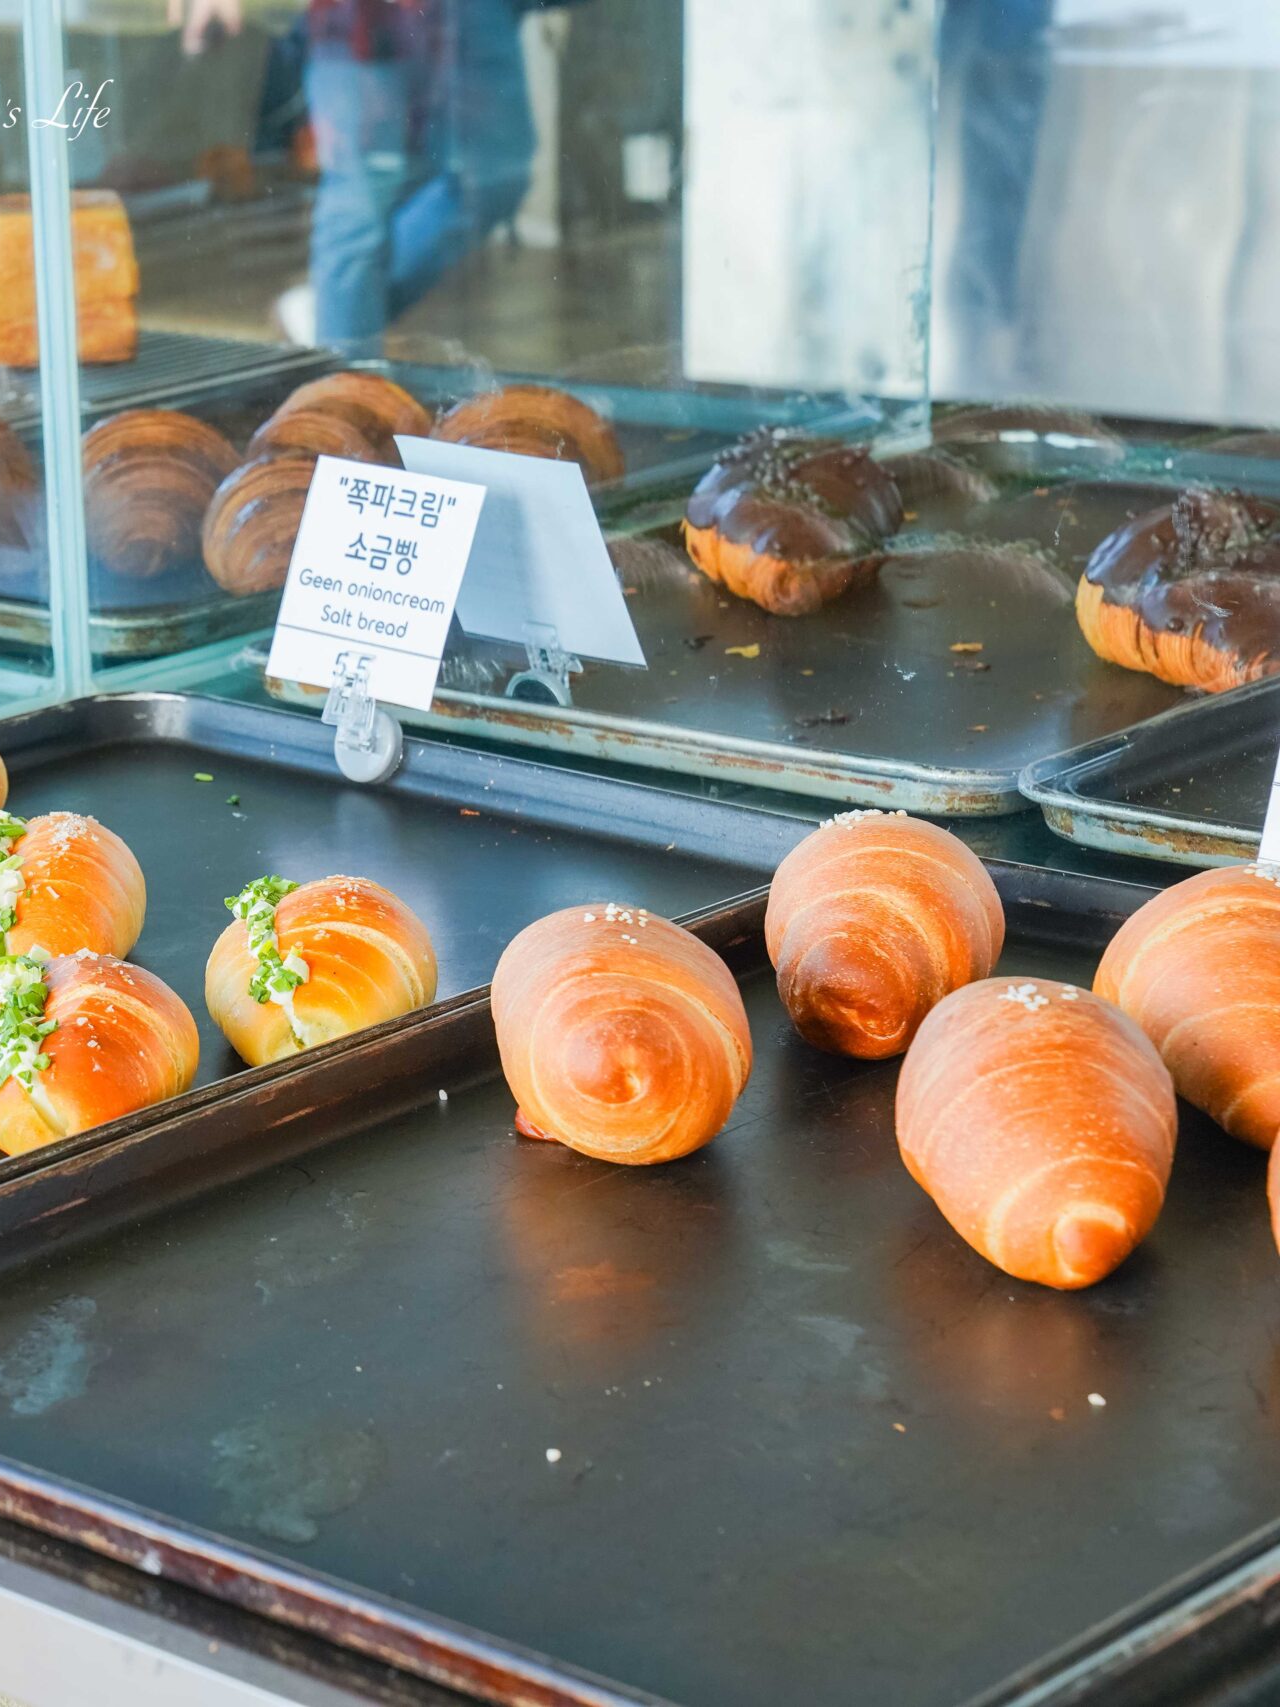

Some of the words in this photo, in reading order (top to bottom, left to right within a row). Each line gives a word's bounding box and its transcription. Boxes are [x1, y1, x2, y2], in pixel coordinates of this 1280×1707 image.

[339, 476, 457, 529] "쪽파크림"
[345, 532, 419, 576] 소금빵
[299, 568, 343, 594] Geen
[347, 581, 446, 615] onioncream
[320, 604, 353, 628] Salt
[358, 611, 410, 639] bread
